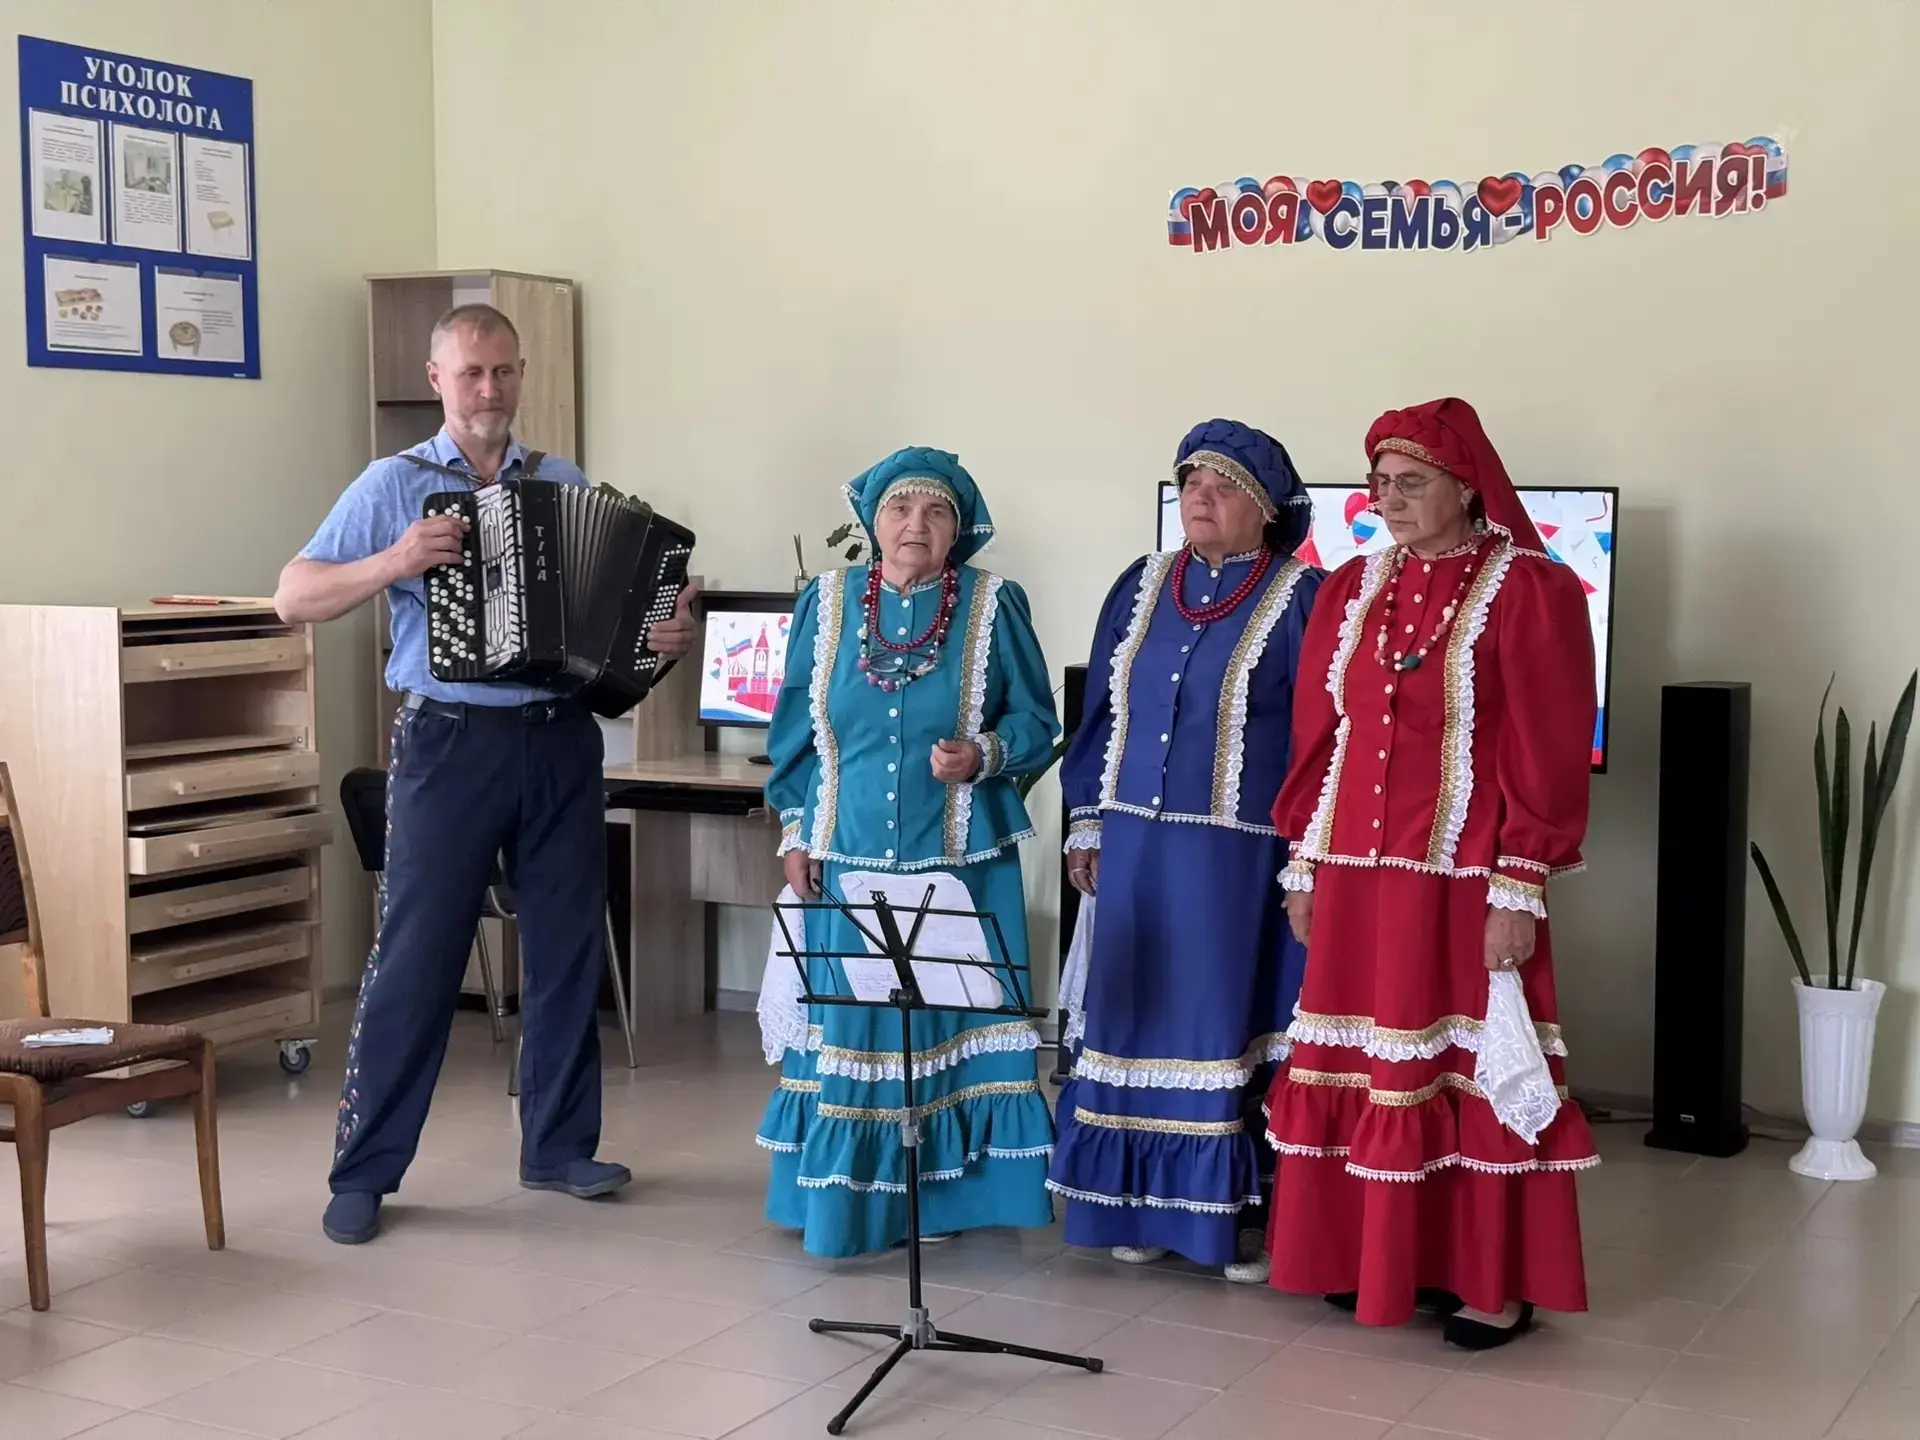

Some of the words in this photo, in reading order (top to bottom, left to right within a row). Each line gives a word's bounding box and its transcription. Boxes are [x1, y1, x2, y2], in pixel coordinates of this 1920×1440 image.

[83, 55, 193, 99] УГОЛОК
[60, 80, 224, 132] ПСИХОЛОГА
[1190, 192, 1300, 254] МОЯ
[1323, 195, 1492, 251] СЕМЬЯ
[1534, 155, 1766, 241] РОССИЯ!
